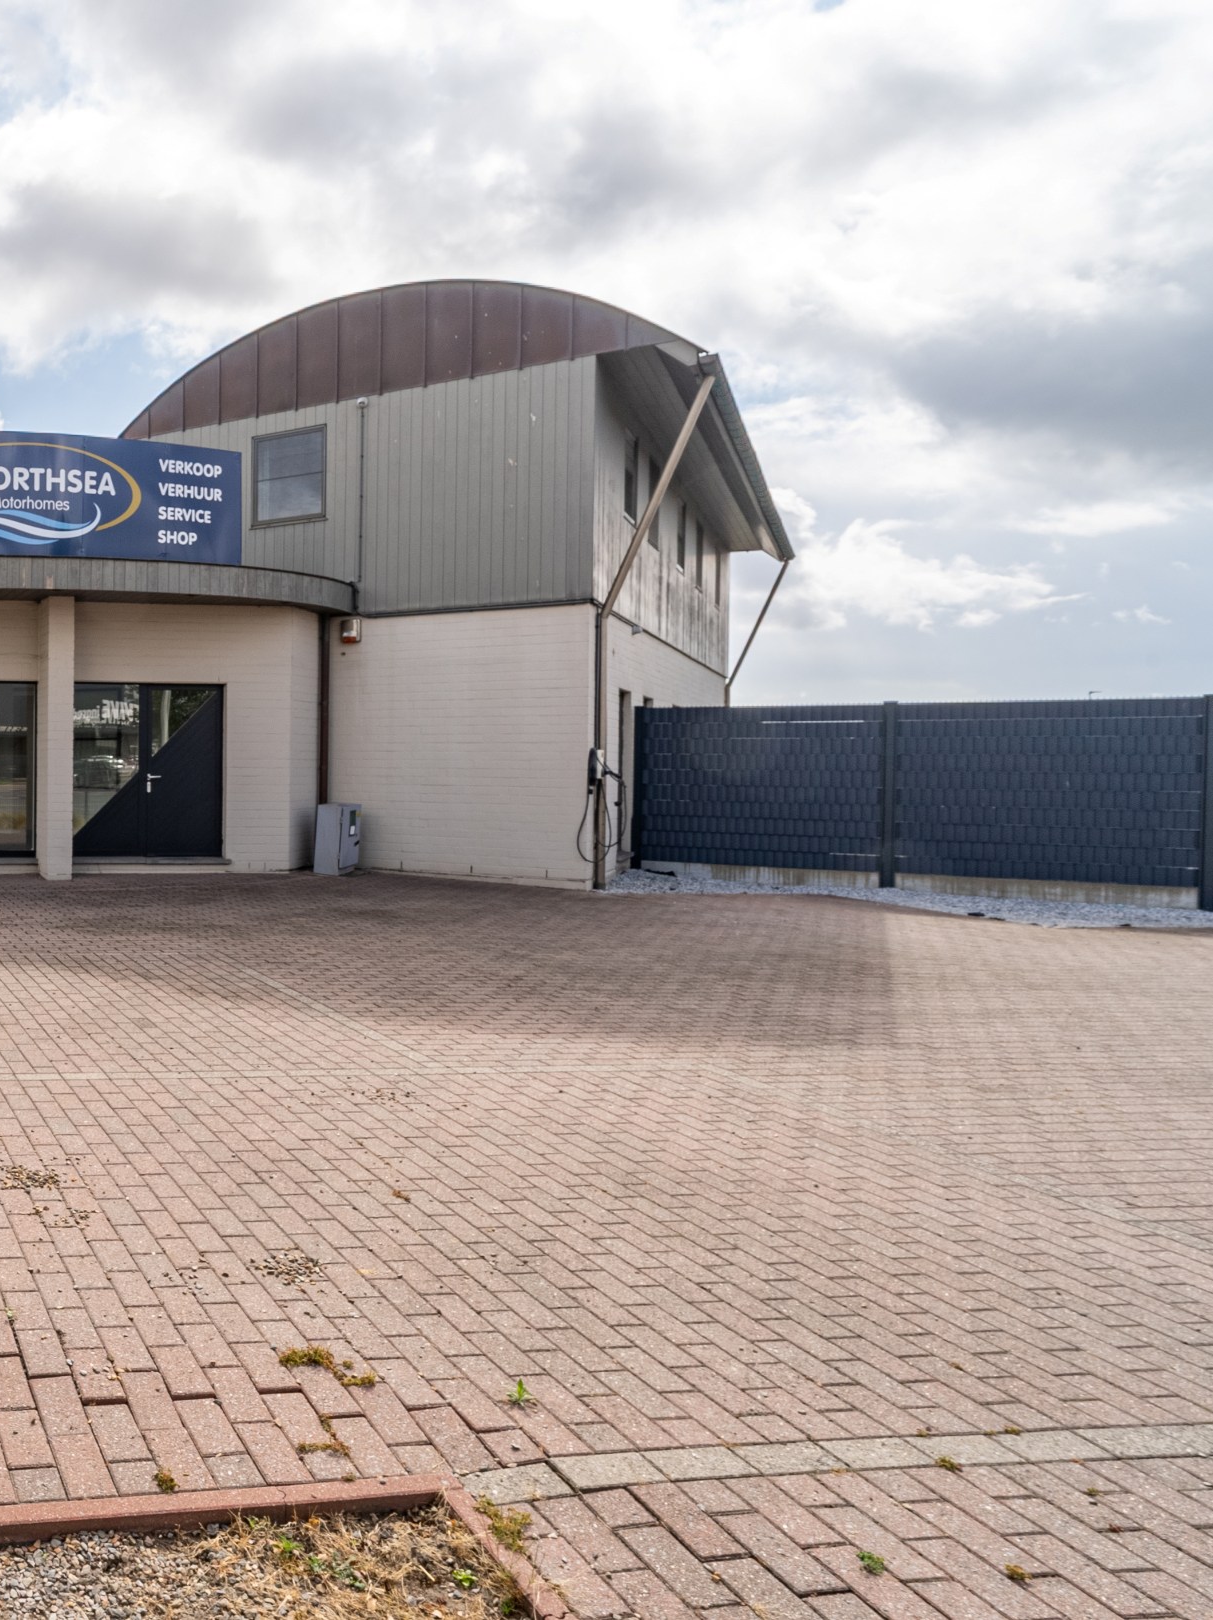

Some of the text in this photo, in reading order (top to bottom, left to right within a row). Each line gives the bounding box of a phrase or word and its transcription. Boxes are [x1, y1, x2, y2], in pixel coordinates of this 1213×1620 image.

[159, 458, 222, 478] VERKOOP
[158, 482, 223, 502] VERHUUR
[158, 506, 212, 524] SERVICE
[157, 529, 198, 546] SHOP
